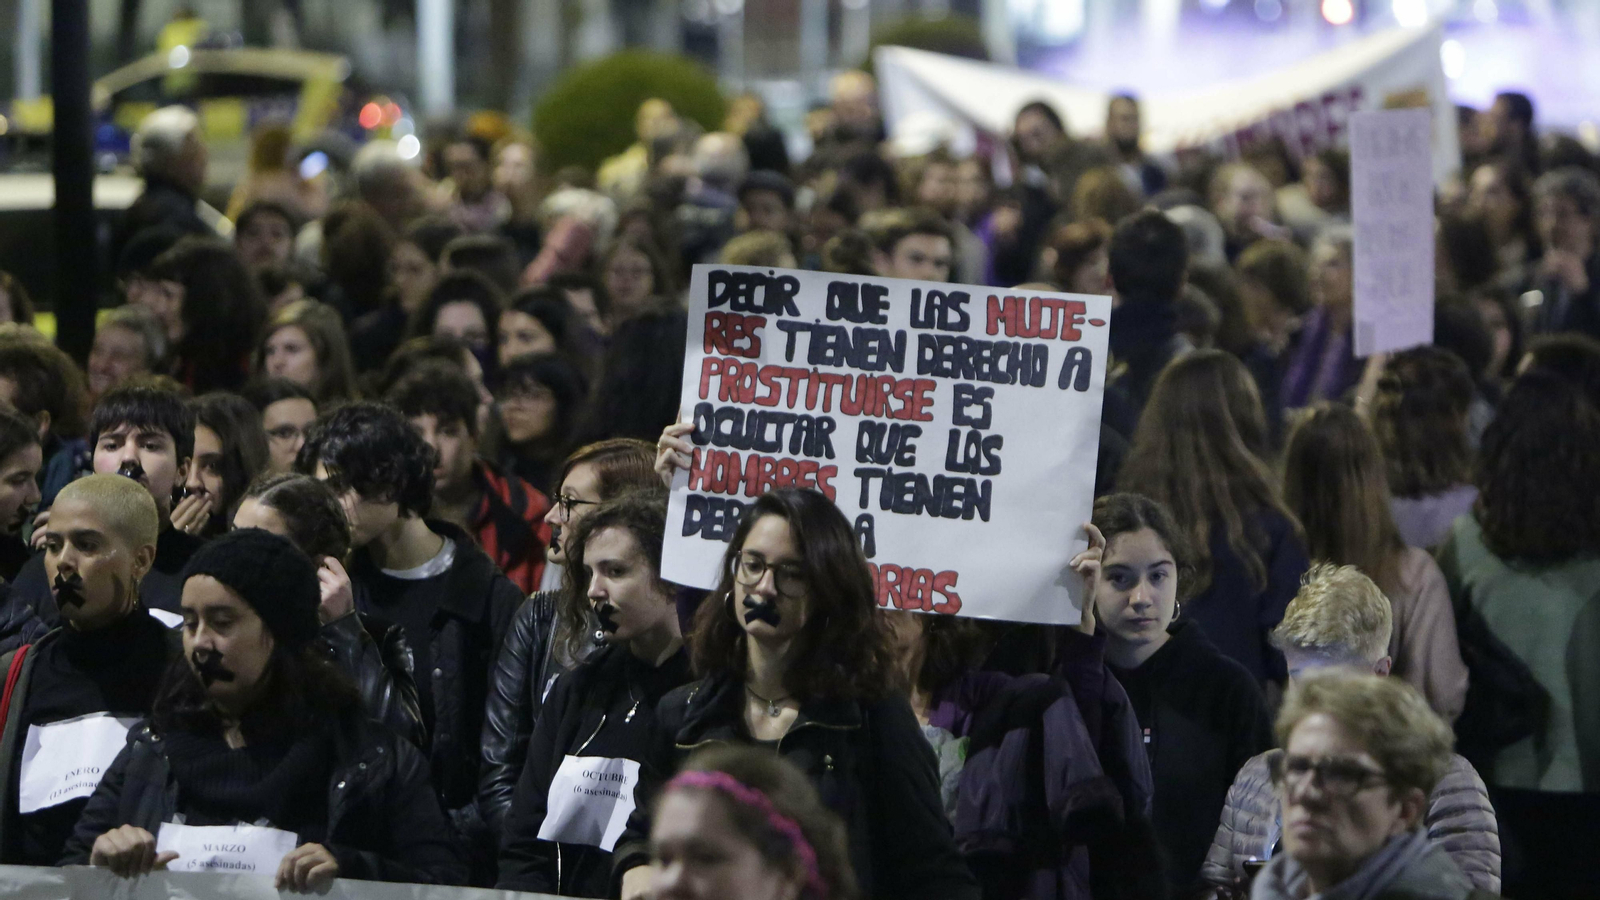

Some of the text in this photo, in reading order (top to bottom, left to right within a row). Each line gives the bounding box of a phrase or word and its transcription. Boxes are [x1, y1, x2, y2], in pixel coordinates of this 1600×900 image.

[708, 270, 801, 317] DECIR
[826, 281, 890, 325] QUE
[910, 288, 970, 332] LAS
[703, 311, 1092, 392] RES TIENEN DERECHO A
[699, 357, 995, 430] PROSTITUIRSE ES
[691, 402, 1003, 476] OCULTAR QUE LOS
[688, 448, 992, 522] HOMBRES TIENEN
[854, 513, 876, 559] A
[64, 766, 100, 781] ENERO
[573, 784, 628, 802] (6 asesinadas)
[582, 770, 628, 785] OCTUBRE
[186, 859, 256, 872] (5 asesinadas)
[202, 843, 247, 853] MARZO
